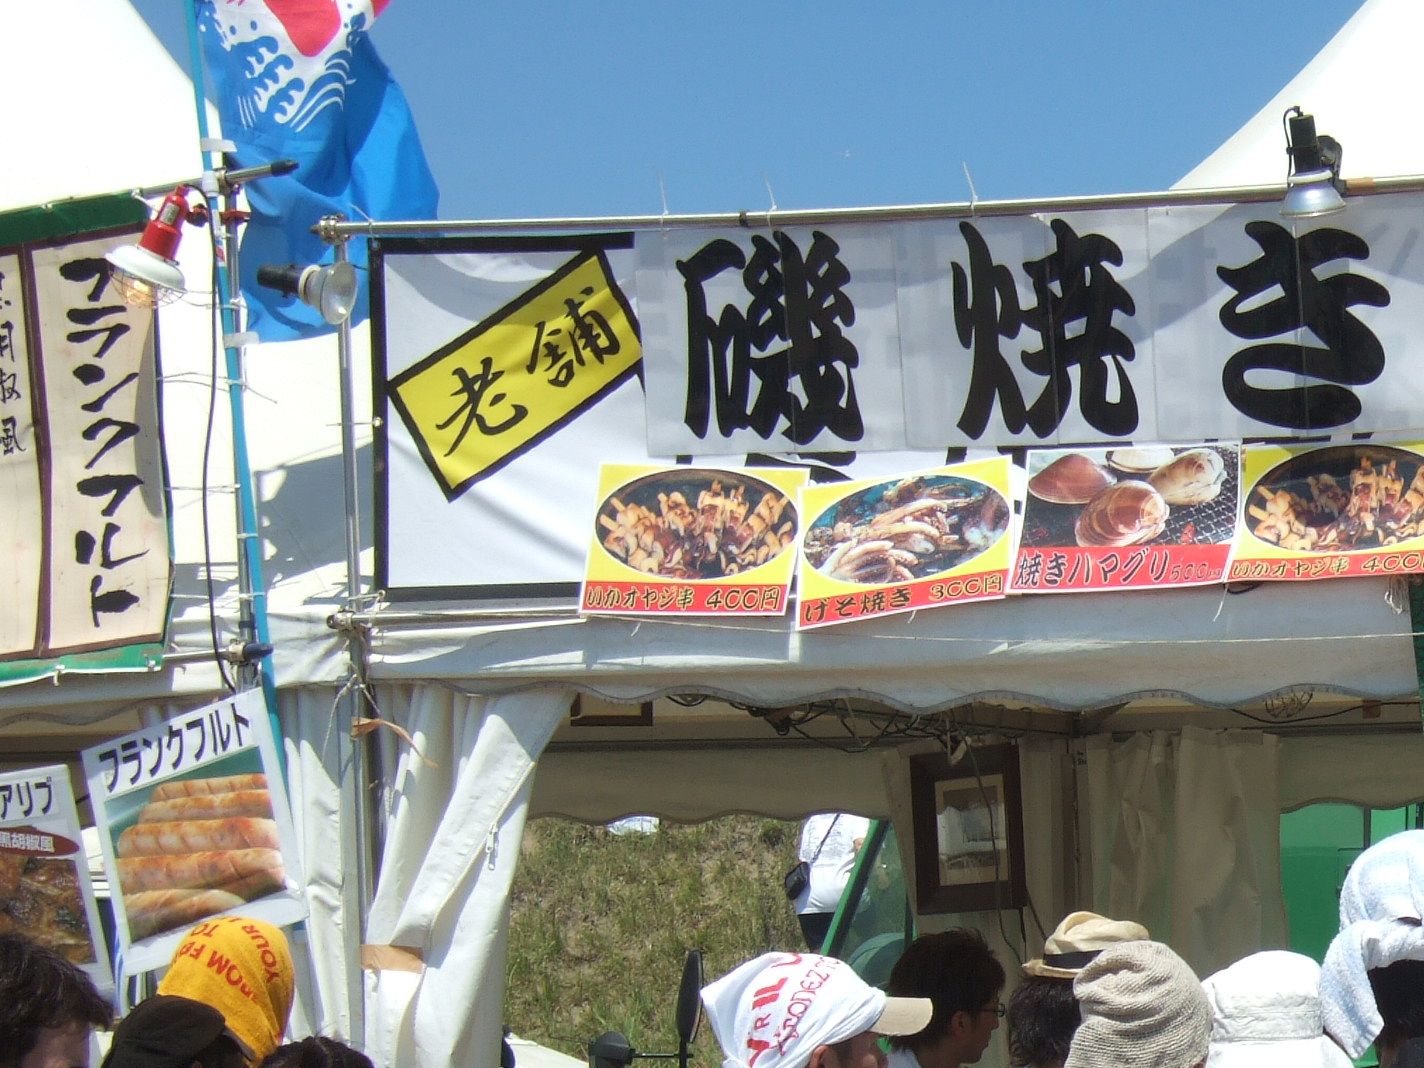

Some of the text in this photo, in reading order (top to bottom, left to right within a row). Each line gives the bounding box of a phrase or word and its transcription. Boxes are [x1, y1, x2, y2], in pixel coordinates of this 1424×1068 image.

[436, 287, 622, 457] 老舗
[705, 585, 779, 610] 400円
[805, 574, 1002, 621] げそ焼き 300円
[99, 702, 250, 793] フランクフルト
